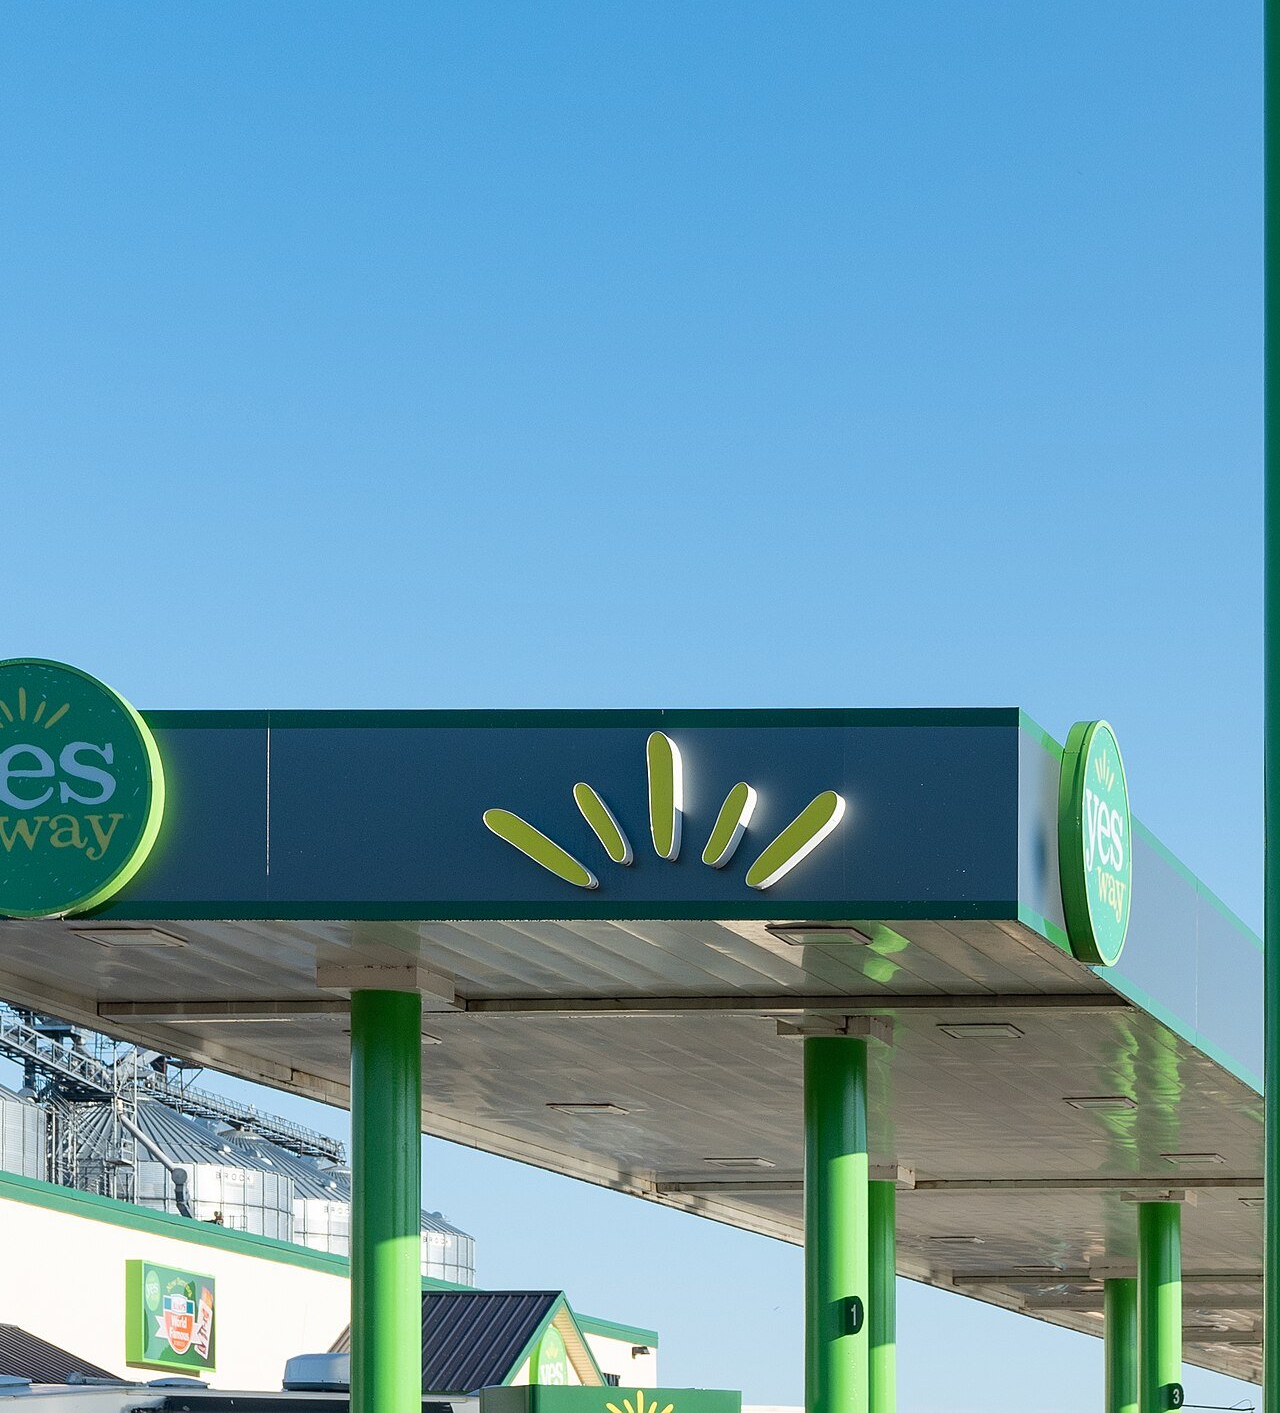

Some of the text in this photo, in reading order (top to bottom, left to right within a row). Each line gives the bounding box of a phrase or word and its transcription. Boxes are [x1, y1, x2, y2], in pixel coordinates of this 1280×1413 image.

[1085, 787, 1124, 873] yes
[1096, 865, 1126, 924] way
[215, 1171, 251, 1183] BROCK
[423, 1236, 449, 1246] BROCK
[851, 1304, 857, 1326] 1
[1173, 1388, 1180, 1404] 3
